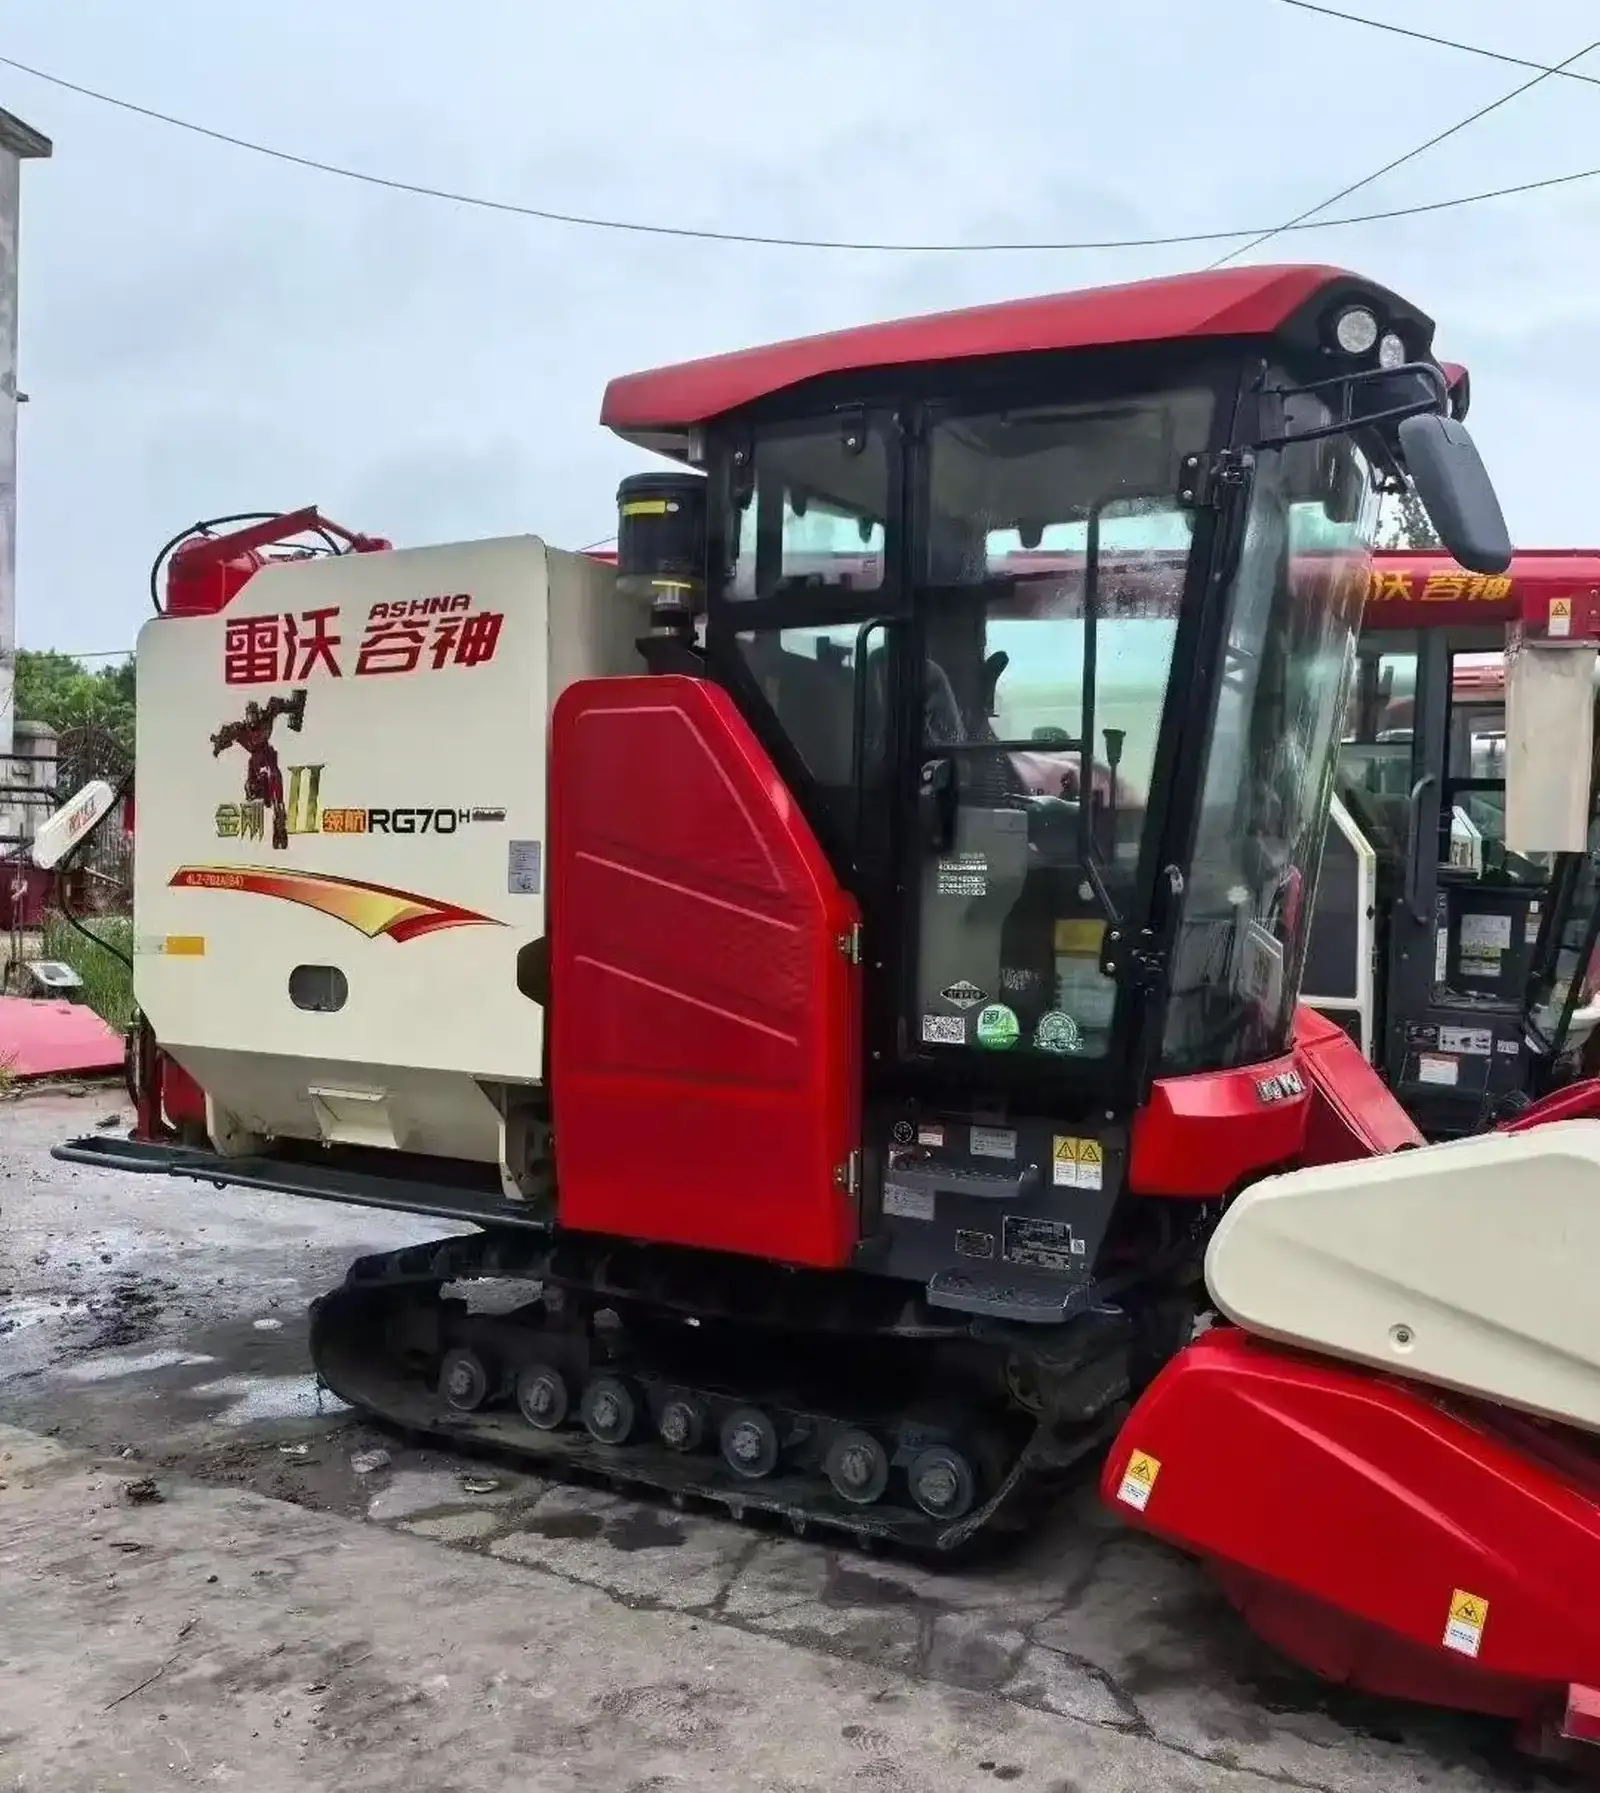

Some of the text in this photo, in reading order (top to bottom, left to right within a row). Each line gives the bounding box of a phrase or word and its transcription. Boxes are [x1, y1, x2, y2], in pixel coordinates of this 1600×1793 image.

[1367, 569, 1513, 601] 沃 谷神
[368, 594, 471, 620] ASHNA
[225, 606, 504, 684] 雷沃 谷神
[215, 803, 264, 842] 金刚
